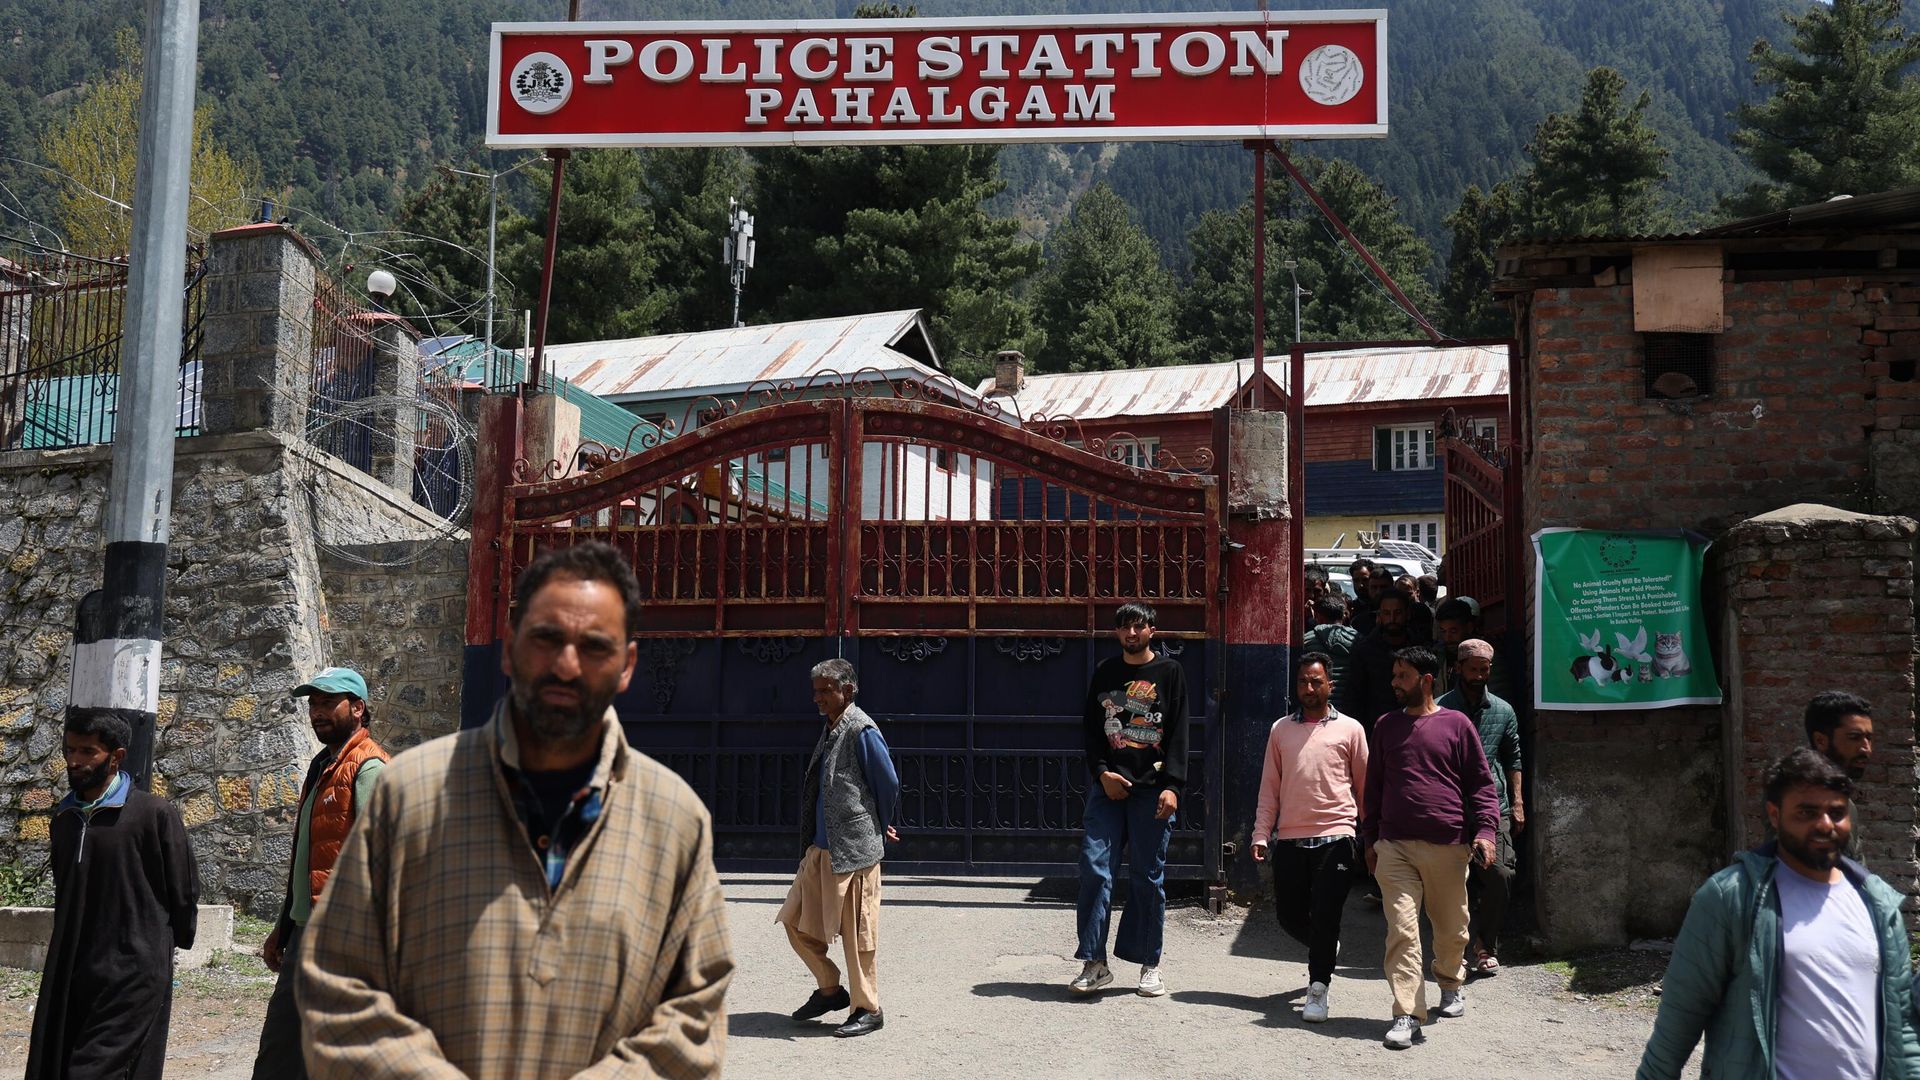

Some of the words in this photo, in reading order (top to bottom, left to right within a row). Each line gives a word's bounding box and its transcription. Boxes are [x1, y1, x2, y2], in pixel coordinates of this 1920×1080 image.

[583, 38, 894, 84] POLICE
[917, 30, 1290, 80] STATION
[745, 84, 1116, 124] PAHALGAM
[1582, 580, 1601, 588] Animal
[1647, 591, 1677, 599] Punishable
[1593, 604, 1620, 612] Offenders
[1145, 712, 1162, 723] 93
